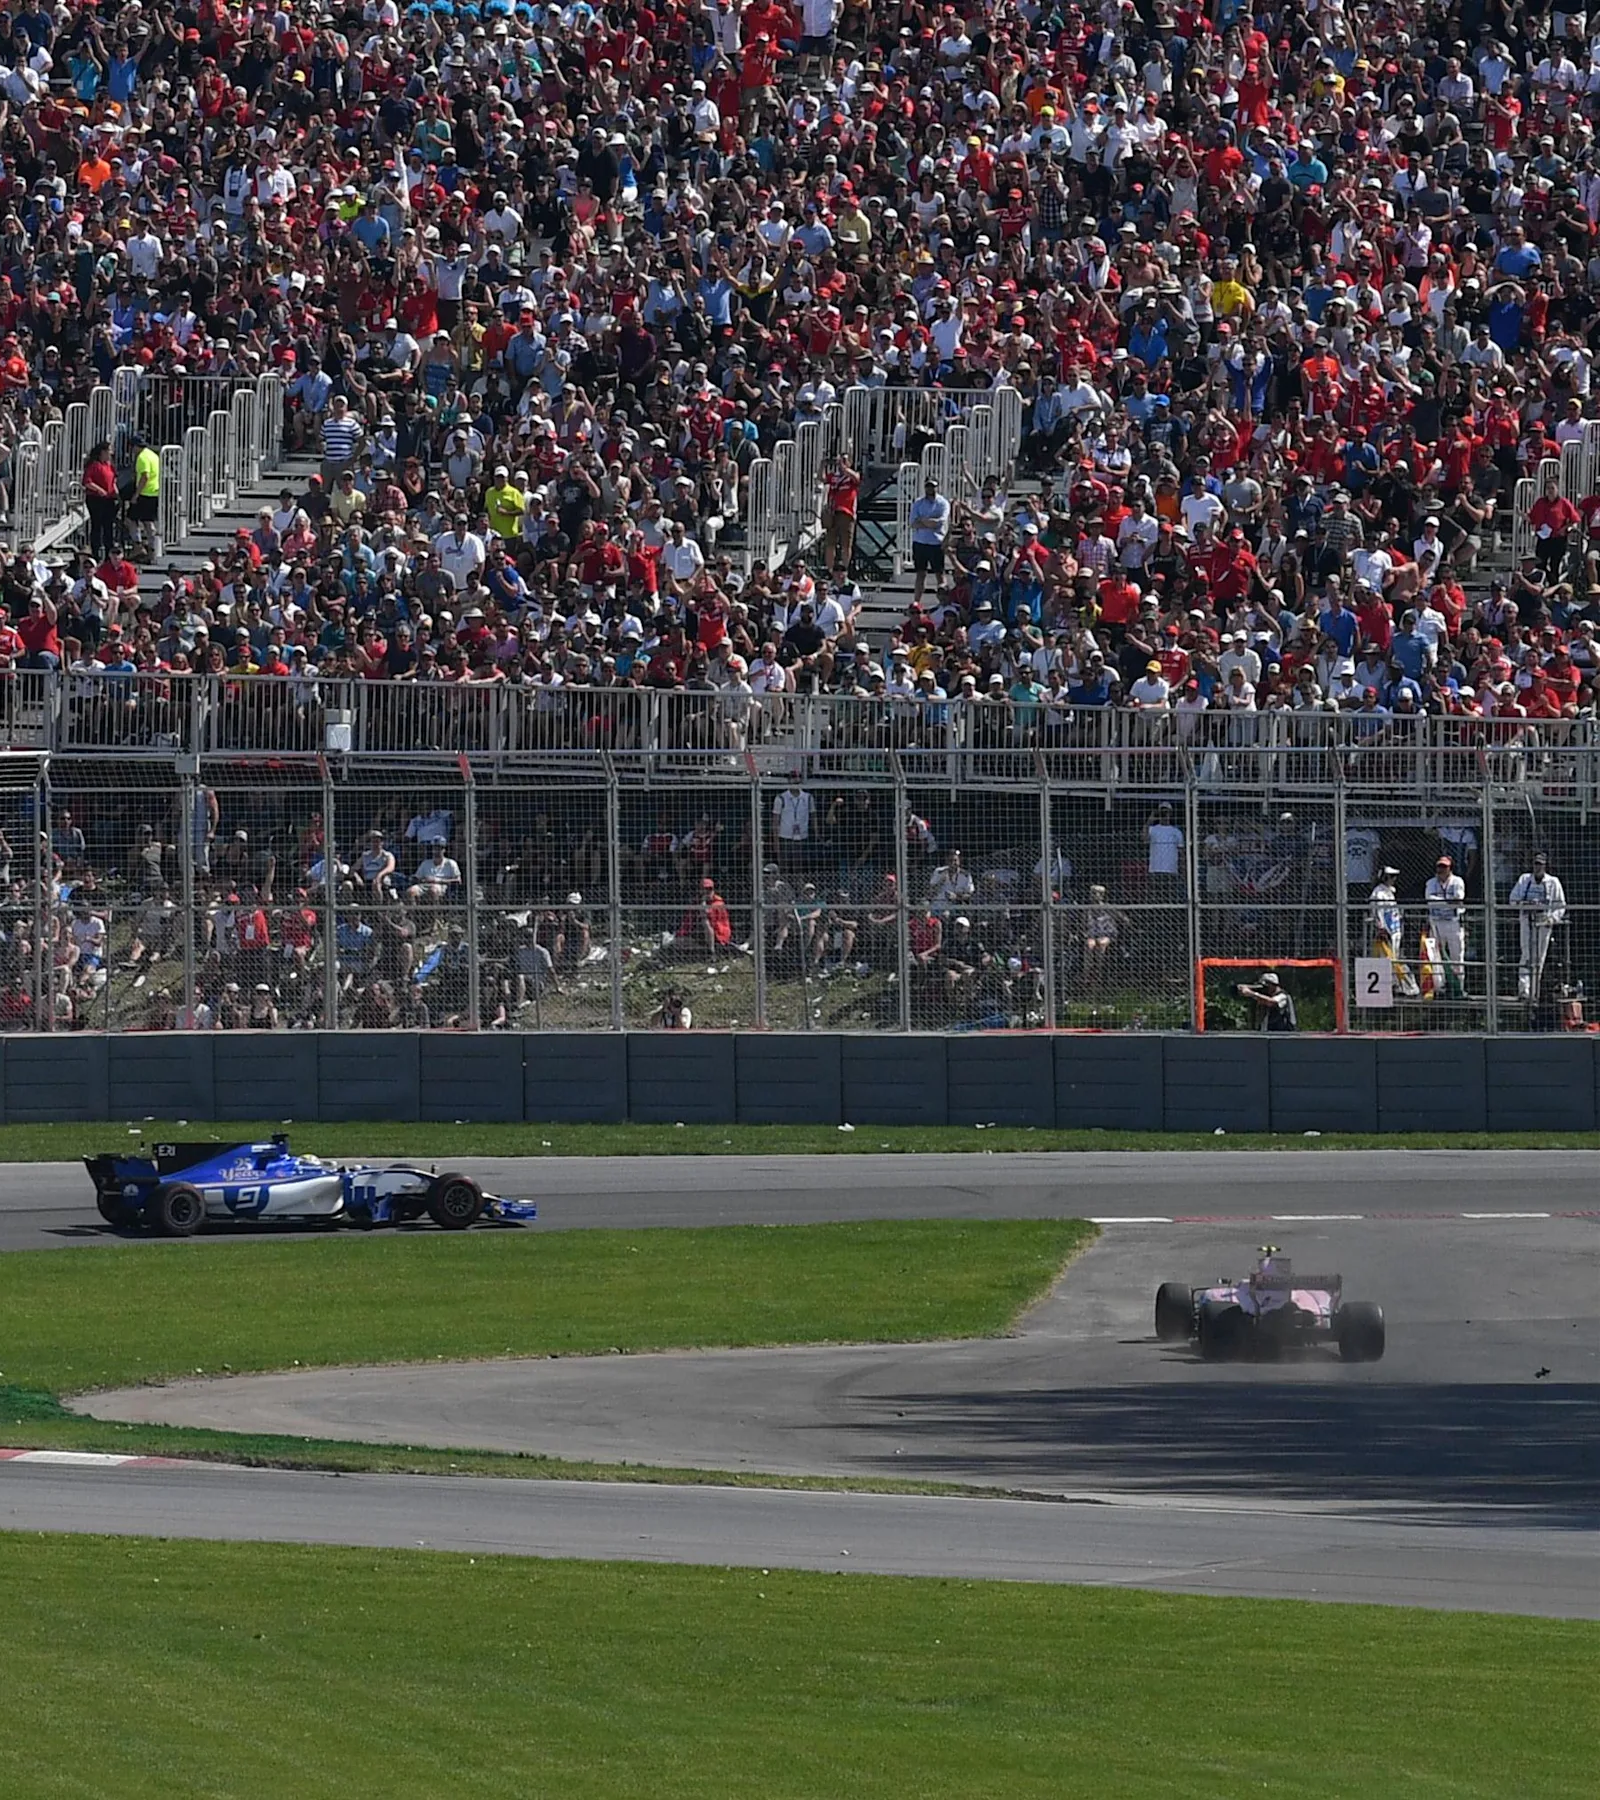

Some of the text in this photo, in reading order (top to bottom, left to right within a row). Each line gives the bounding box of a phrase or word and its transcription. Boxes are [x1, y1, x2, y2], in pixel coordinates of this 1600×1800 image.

[1367, 971, 1380, 994] 2
[158, 1145, 176, 1157] ERI
[234, 1158, 252, 1170] 25
